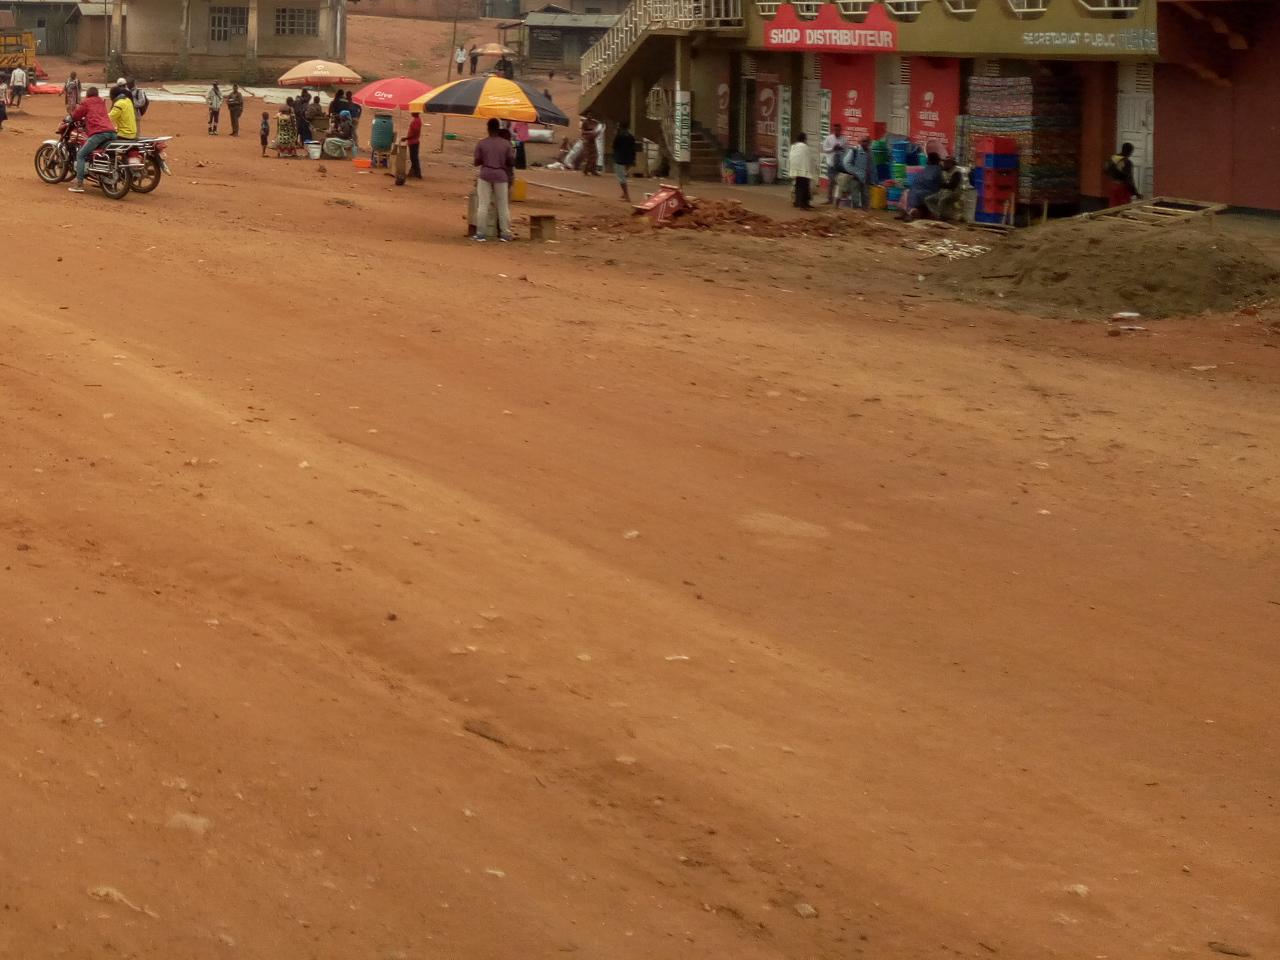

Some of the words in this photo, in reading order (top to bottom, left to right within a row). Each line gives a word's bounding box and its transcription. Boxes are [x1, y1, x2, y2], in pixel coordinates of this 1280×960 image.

[770, 28, 800, 44] SHOP
[805, 29, 893, 48] DISTRIBUTEUR
[1083, 33, 1116, 46] PUBLIC
[374, 91, 394, 99] Give
[919, 111, 939, 121] airtel
